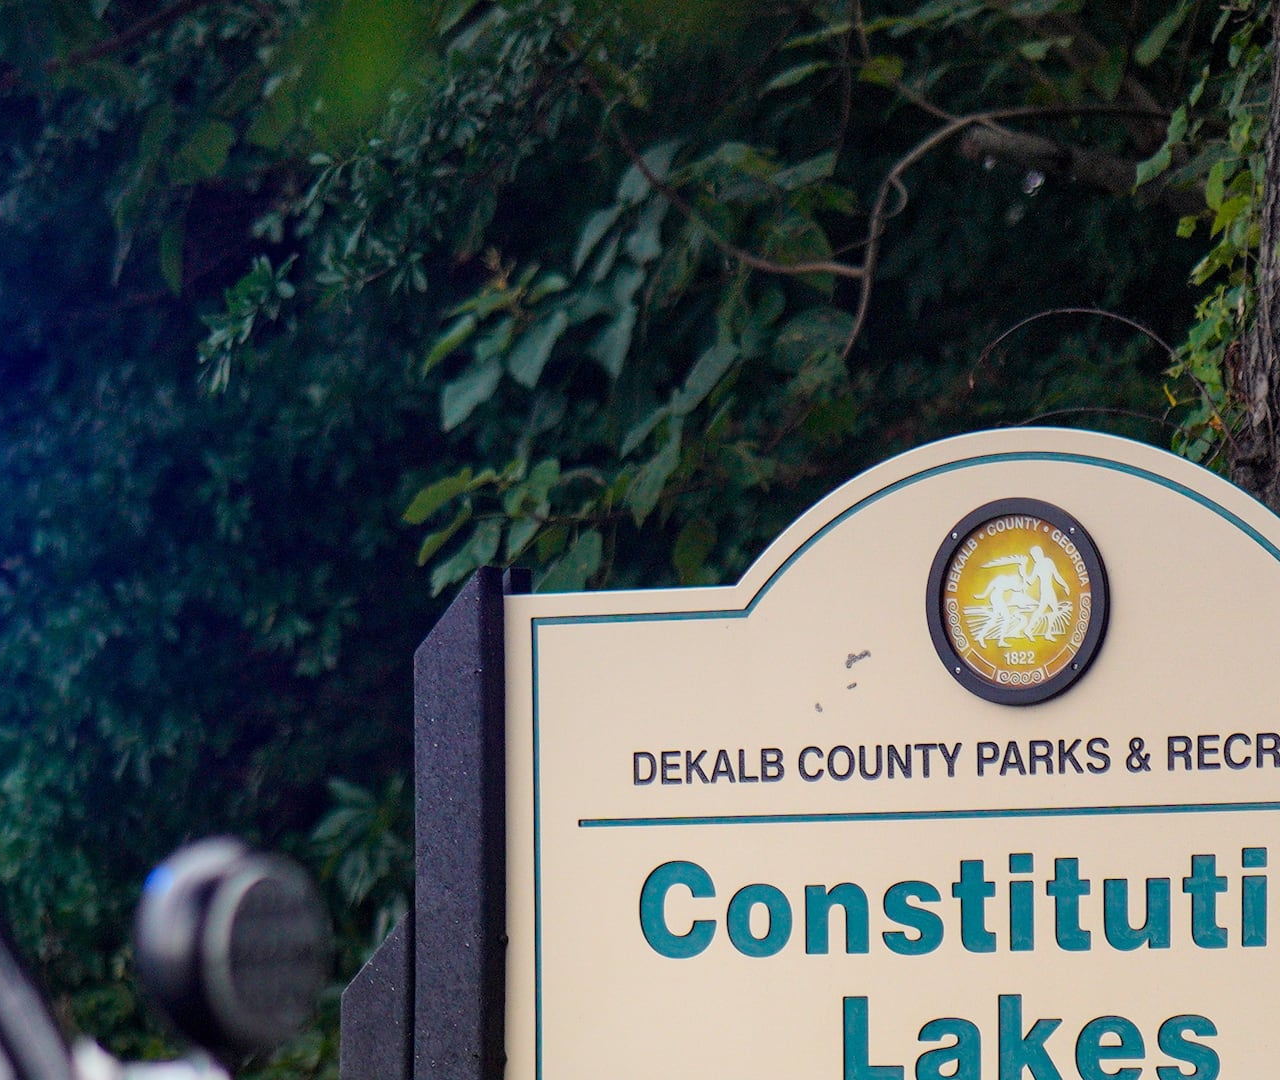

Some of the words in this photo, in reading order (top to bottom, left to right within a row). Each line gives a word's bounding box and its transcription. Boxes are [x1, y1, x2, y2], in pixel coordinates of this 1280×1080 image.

[947, 538, 978, 592] DEKALB
[987, 517, 1041, 537] COUNTY
[1051, 530, 1090, 587] GEORGIA
[1004, 651, 1035, 665] 1822
[633, 748, 784, 785] DEKALB
[798, 743, 962, 782] COUNTY
[977, 737, 1111, 776] PARKS
[1126, 737, 1151, 773] &
